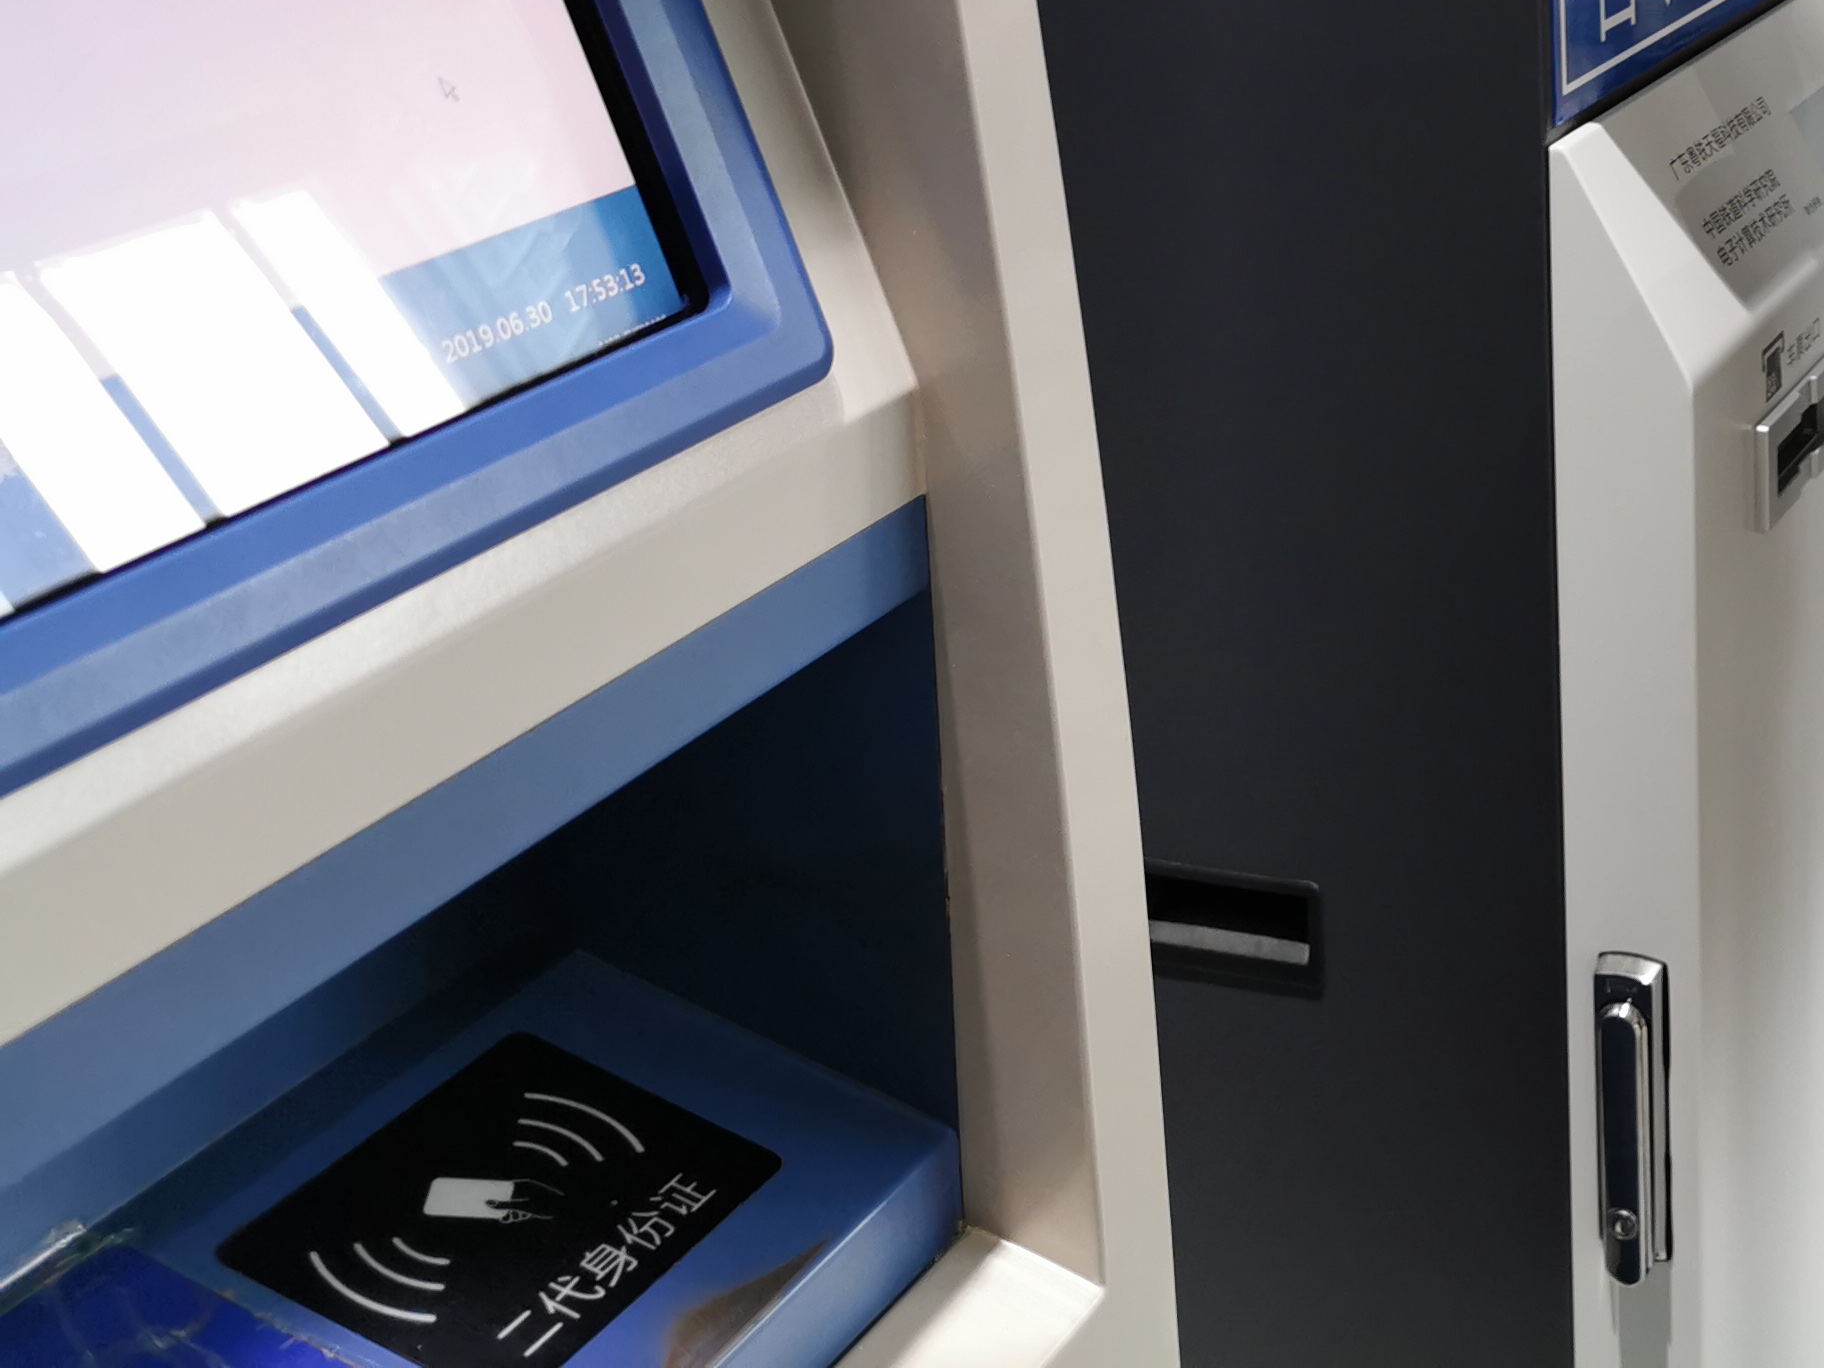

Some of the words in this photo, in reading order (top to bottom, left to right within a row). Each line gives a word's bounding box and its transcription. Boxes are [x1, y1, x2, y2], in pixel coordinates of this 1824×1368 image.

[441, 300, 554, 364] 2019.06.30
[564, 262, 647, 314] 17:53:13
[496, 1173, 717, 1358] 二代身份证
